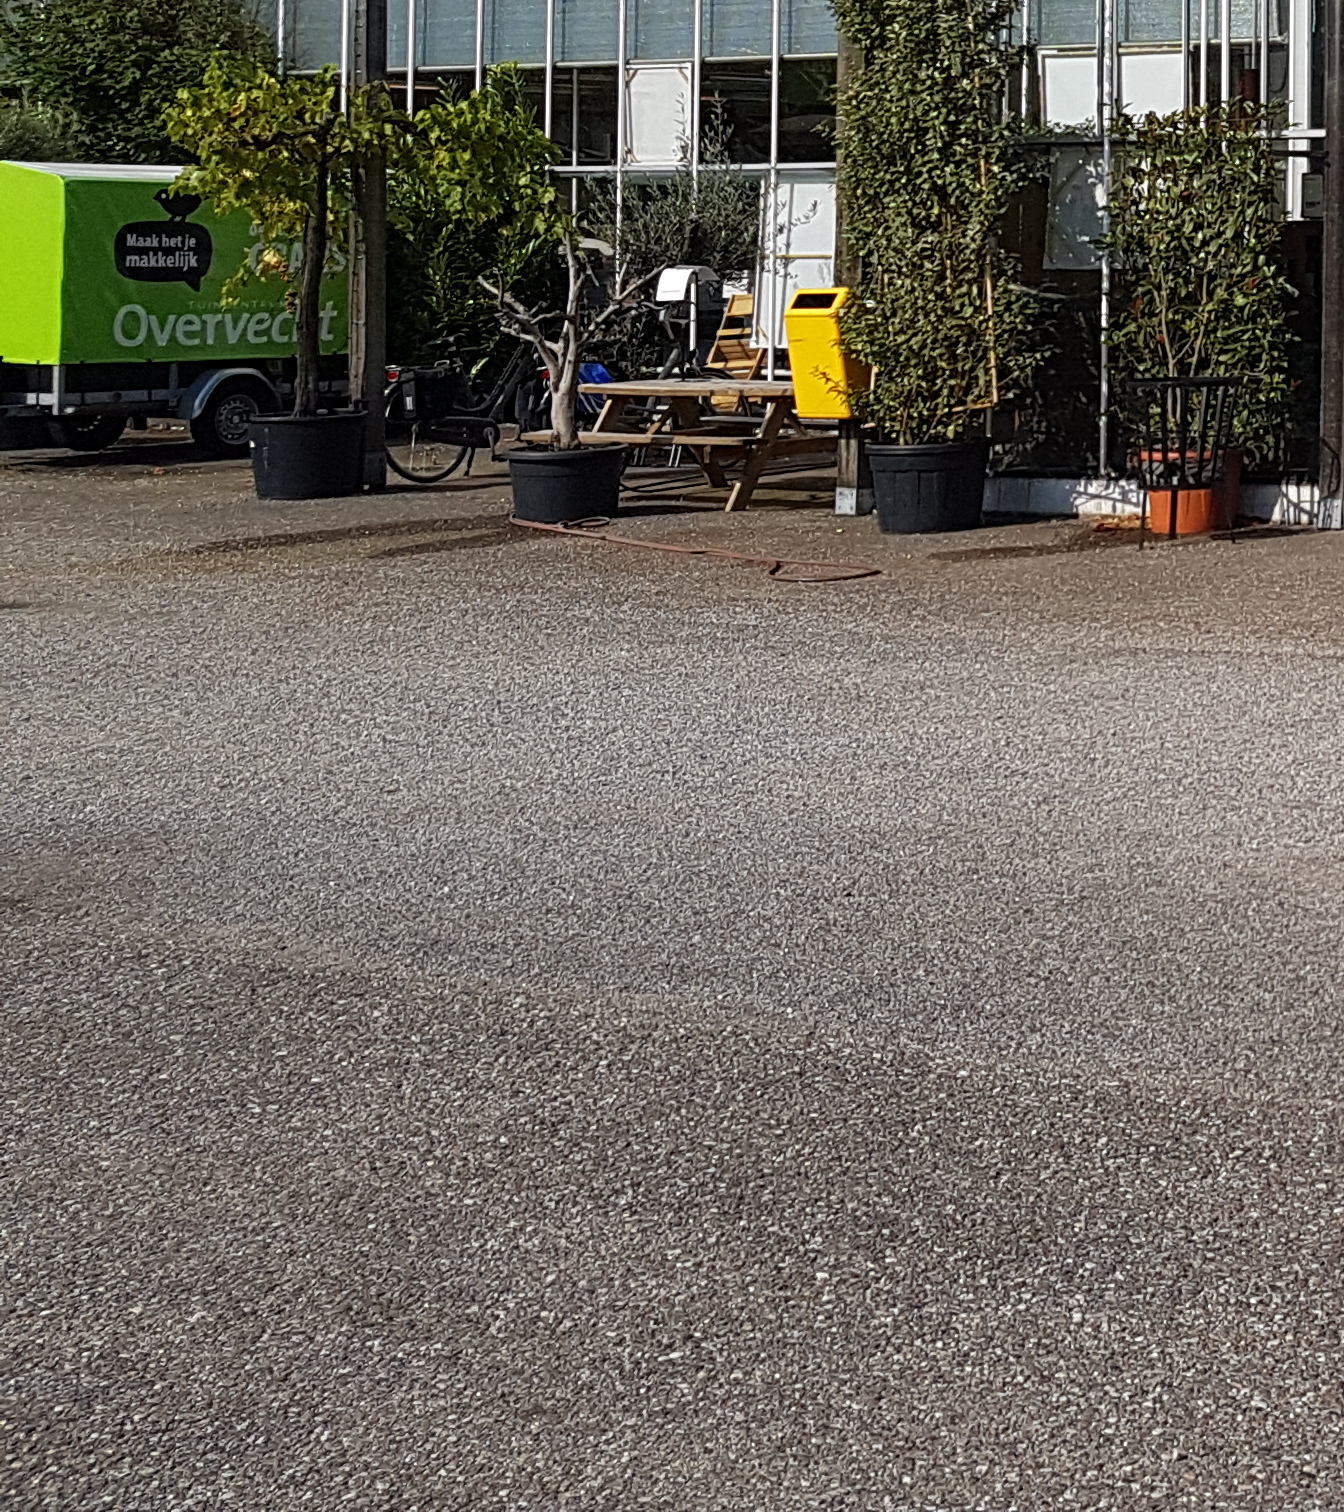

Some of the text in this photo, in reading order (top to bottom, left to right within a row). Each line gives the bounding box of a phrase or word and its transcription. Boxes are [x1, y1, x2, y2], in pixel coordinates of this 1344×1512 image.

[126, 234, 196, 251] Maak het je
[125, 251, 199, 272] makkelijk
[112, 300, 338, 348] Overvect
